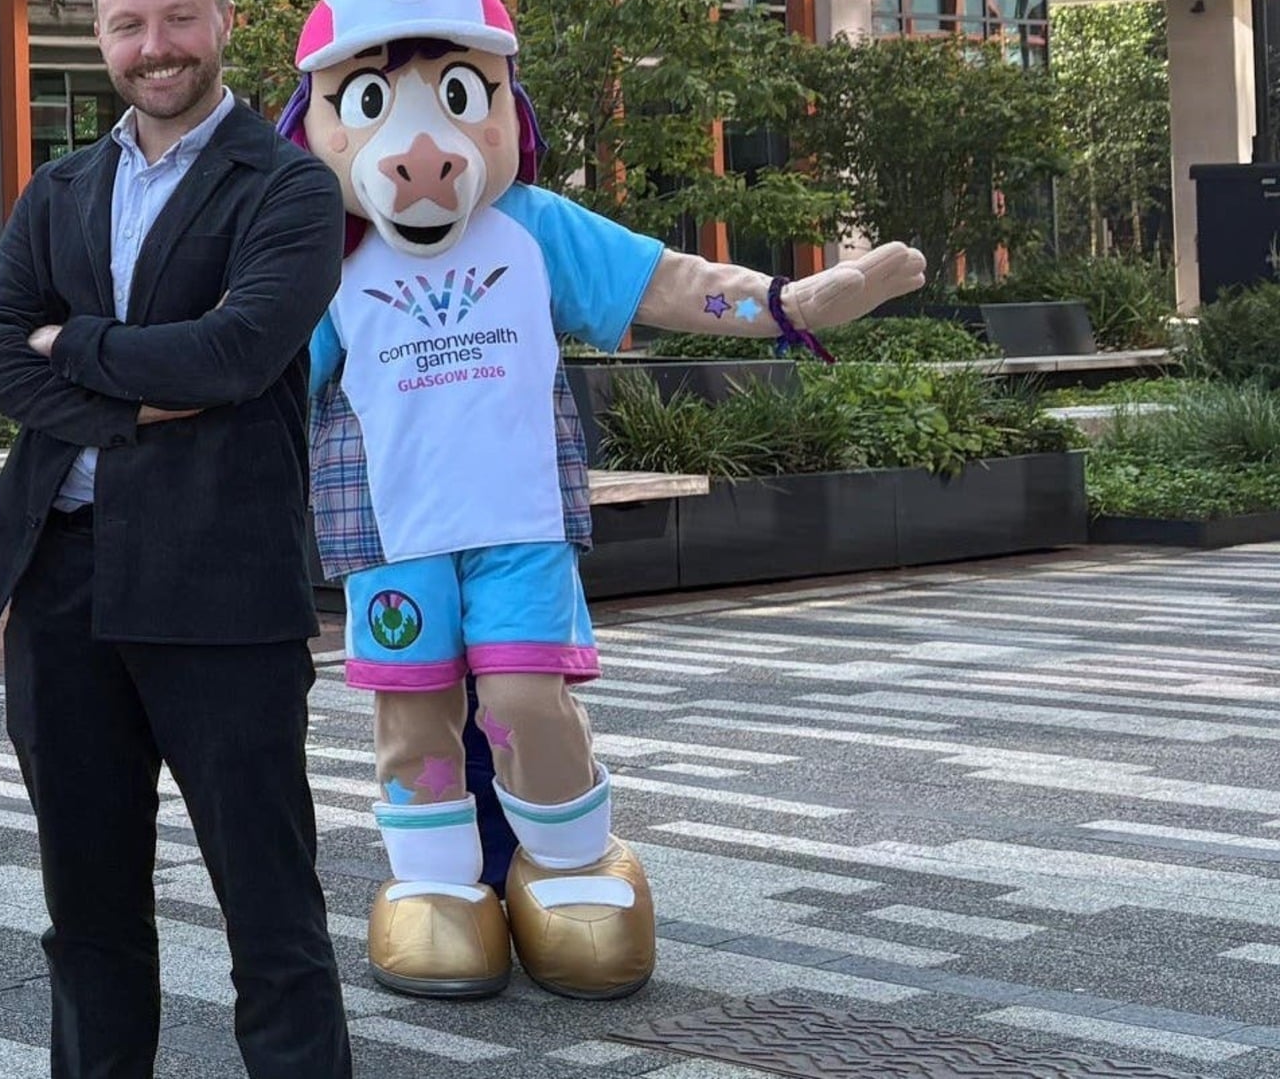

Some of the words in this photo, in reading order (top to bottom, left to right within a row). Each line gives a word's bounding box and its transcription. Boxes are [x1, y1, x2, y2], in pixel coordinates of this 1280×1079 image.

[379, 328, 518, 363] commonwealth
[416, 346, 483, 372] games
[397, 368, 468, 393] GLASGOW
[472, 365, 506, 379] 2026
